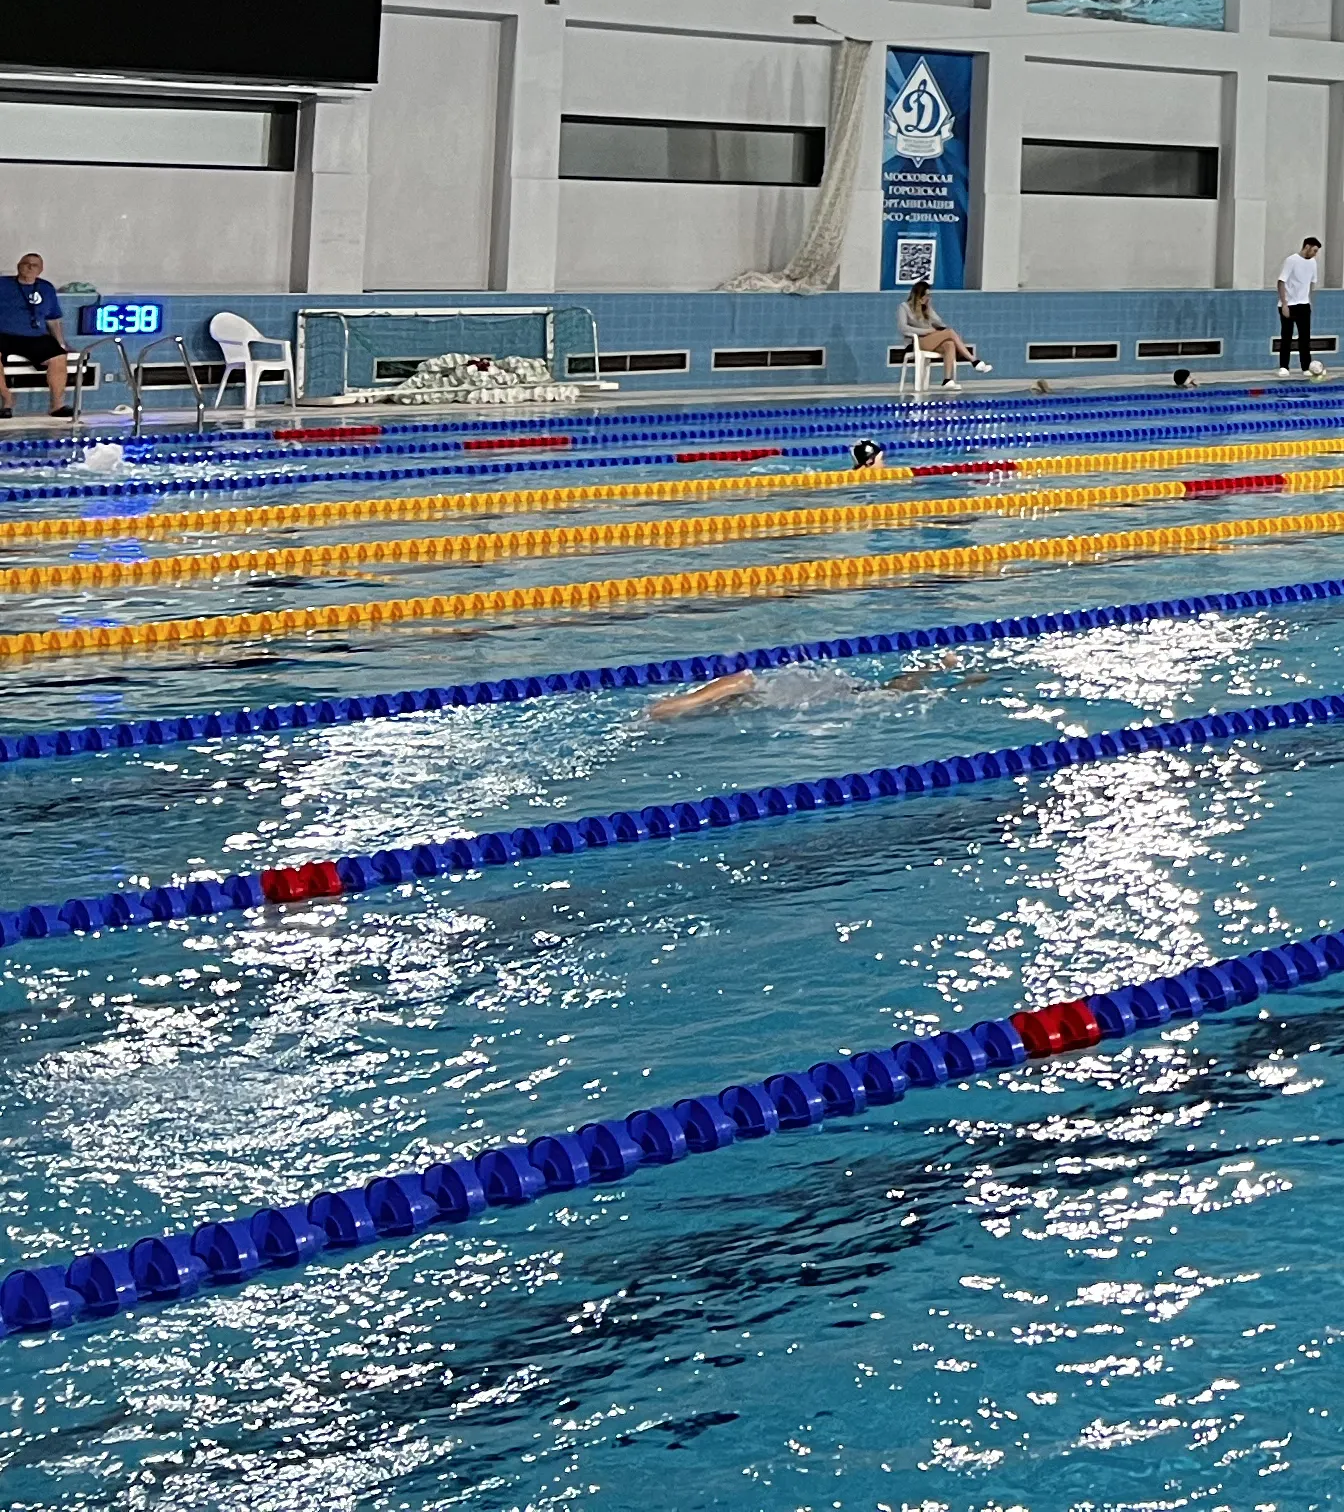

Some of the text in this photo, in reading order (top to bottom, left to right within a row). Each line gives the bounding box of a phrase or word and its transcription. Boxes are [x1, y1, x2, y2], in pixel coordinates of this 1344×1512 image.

[883, 171, 954, 183] МОСКОВСКАЯ
[888, 185, 948, 196] ГОРОДСКАЯ
[883, 198, 955, 209] ОРГАНИЗАЦИЯ
[96, 304, 159, 333] 16:38
